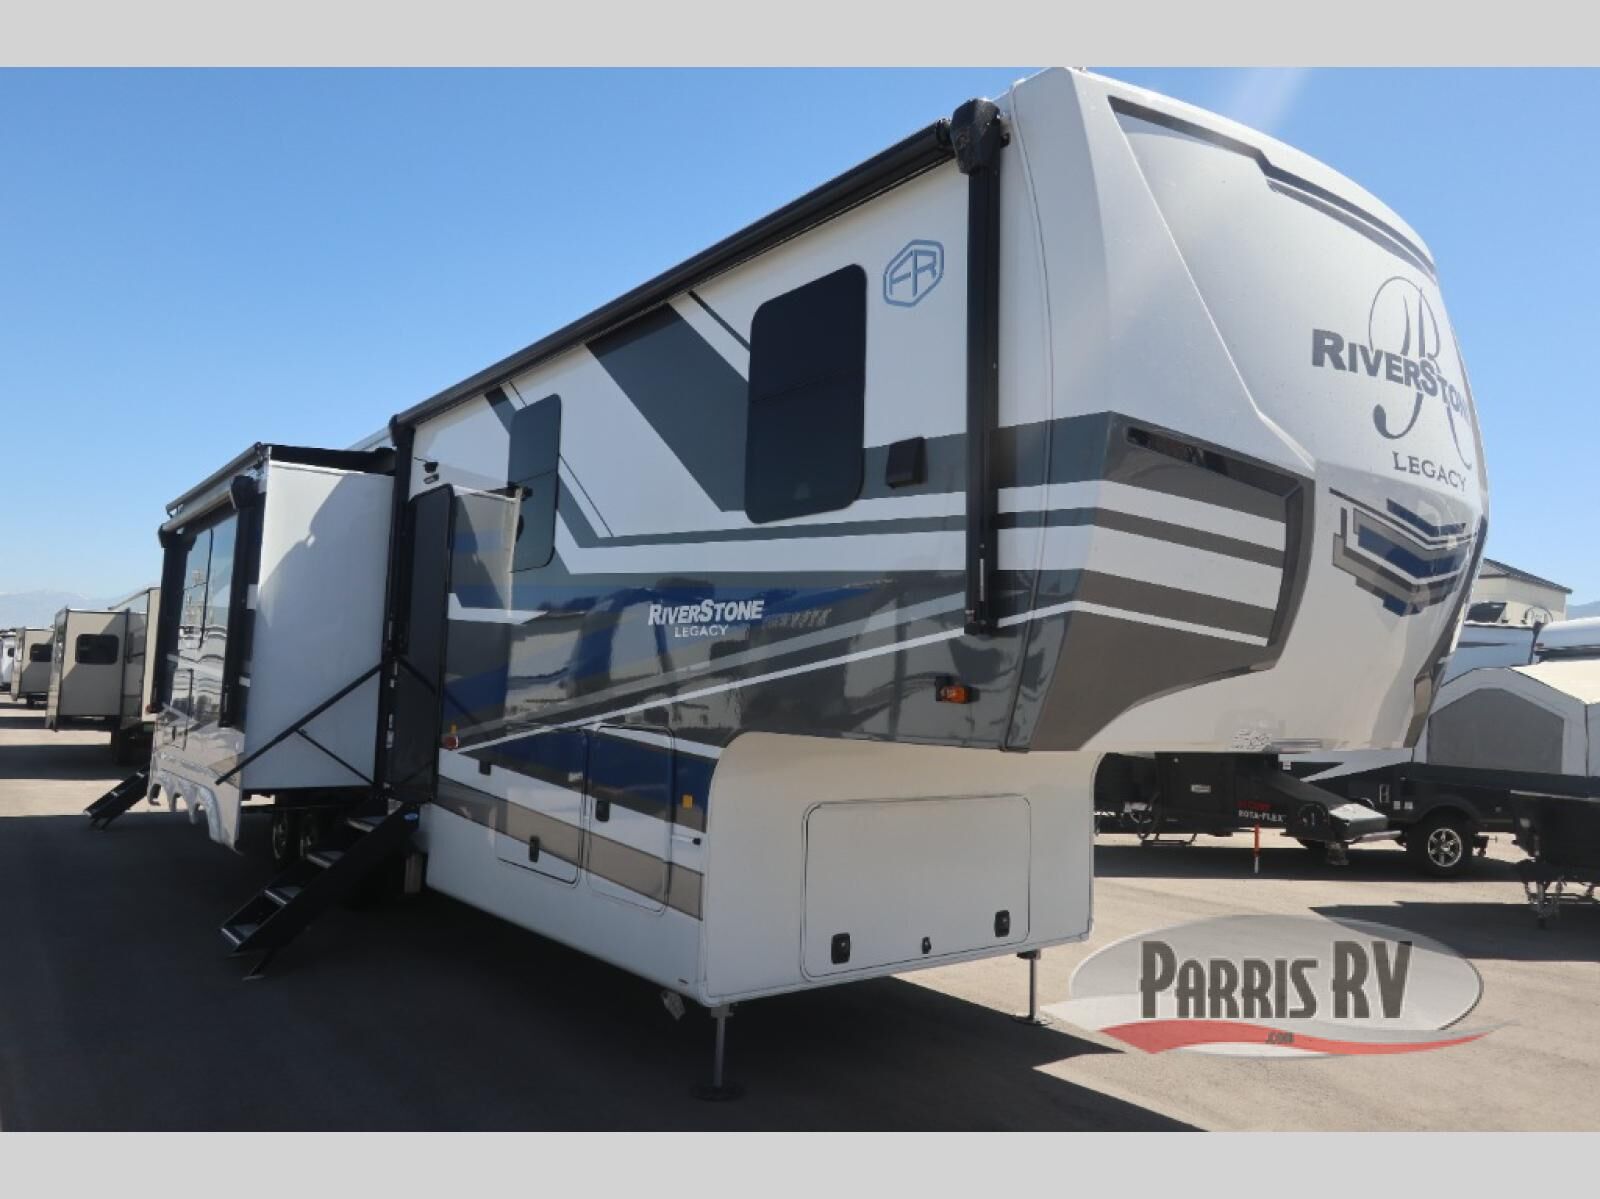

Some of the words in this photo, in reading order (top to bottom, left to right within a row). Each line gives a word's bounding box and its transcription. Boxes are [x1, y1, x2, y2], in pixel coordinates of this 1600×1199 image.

[1392, 451, 1466, 493] LEGACY
[648, 599, 765, 626] RIVERSTONE
[674, 624, 729, 638] LEGACY
